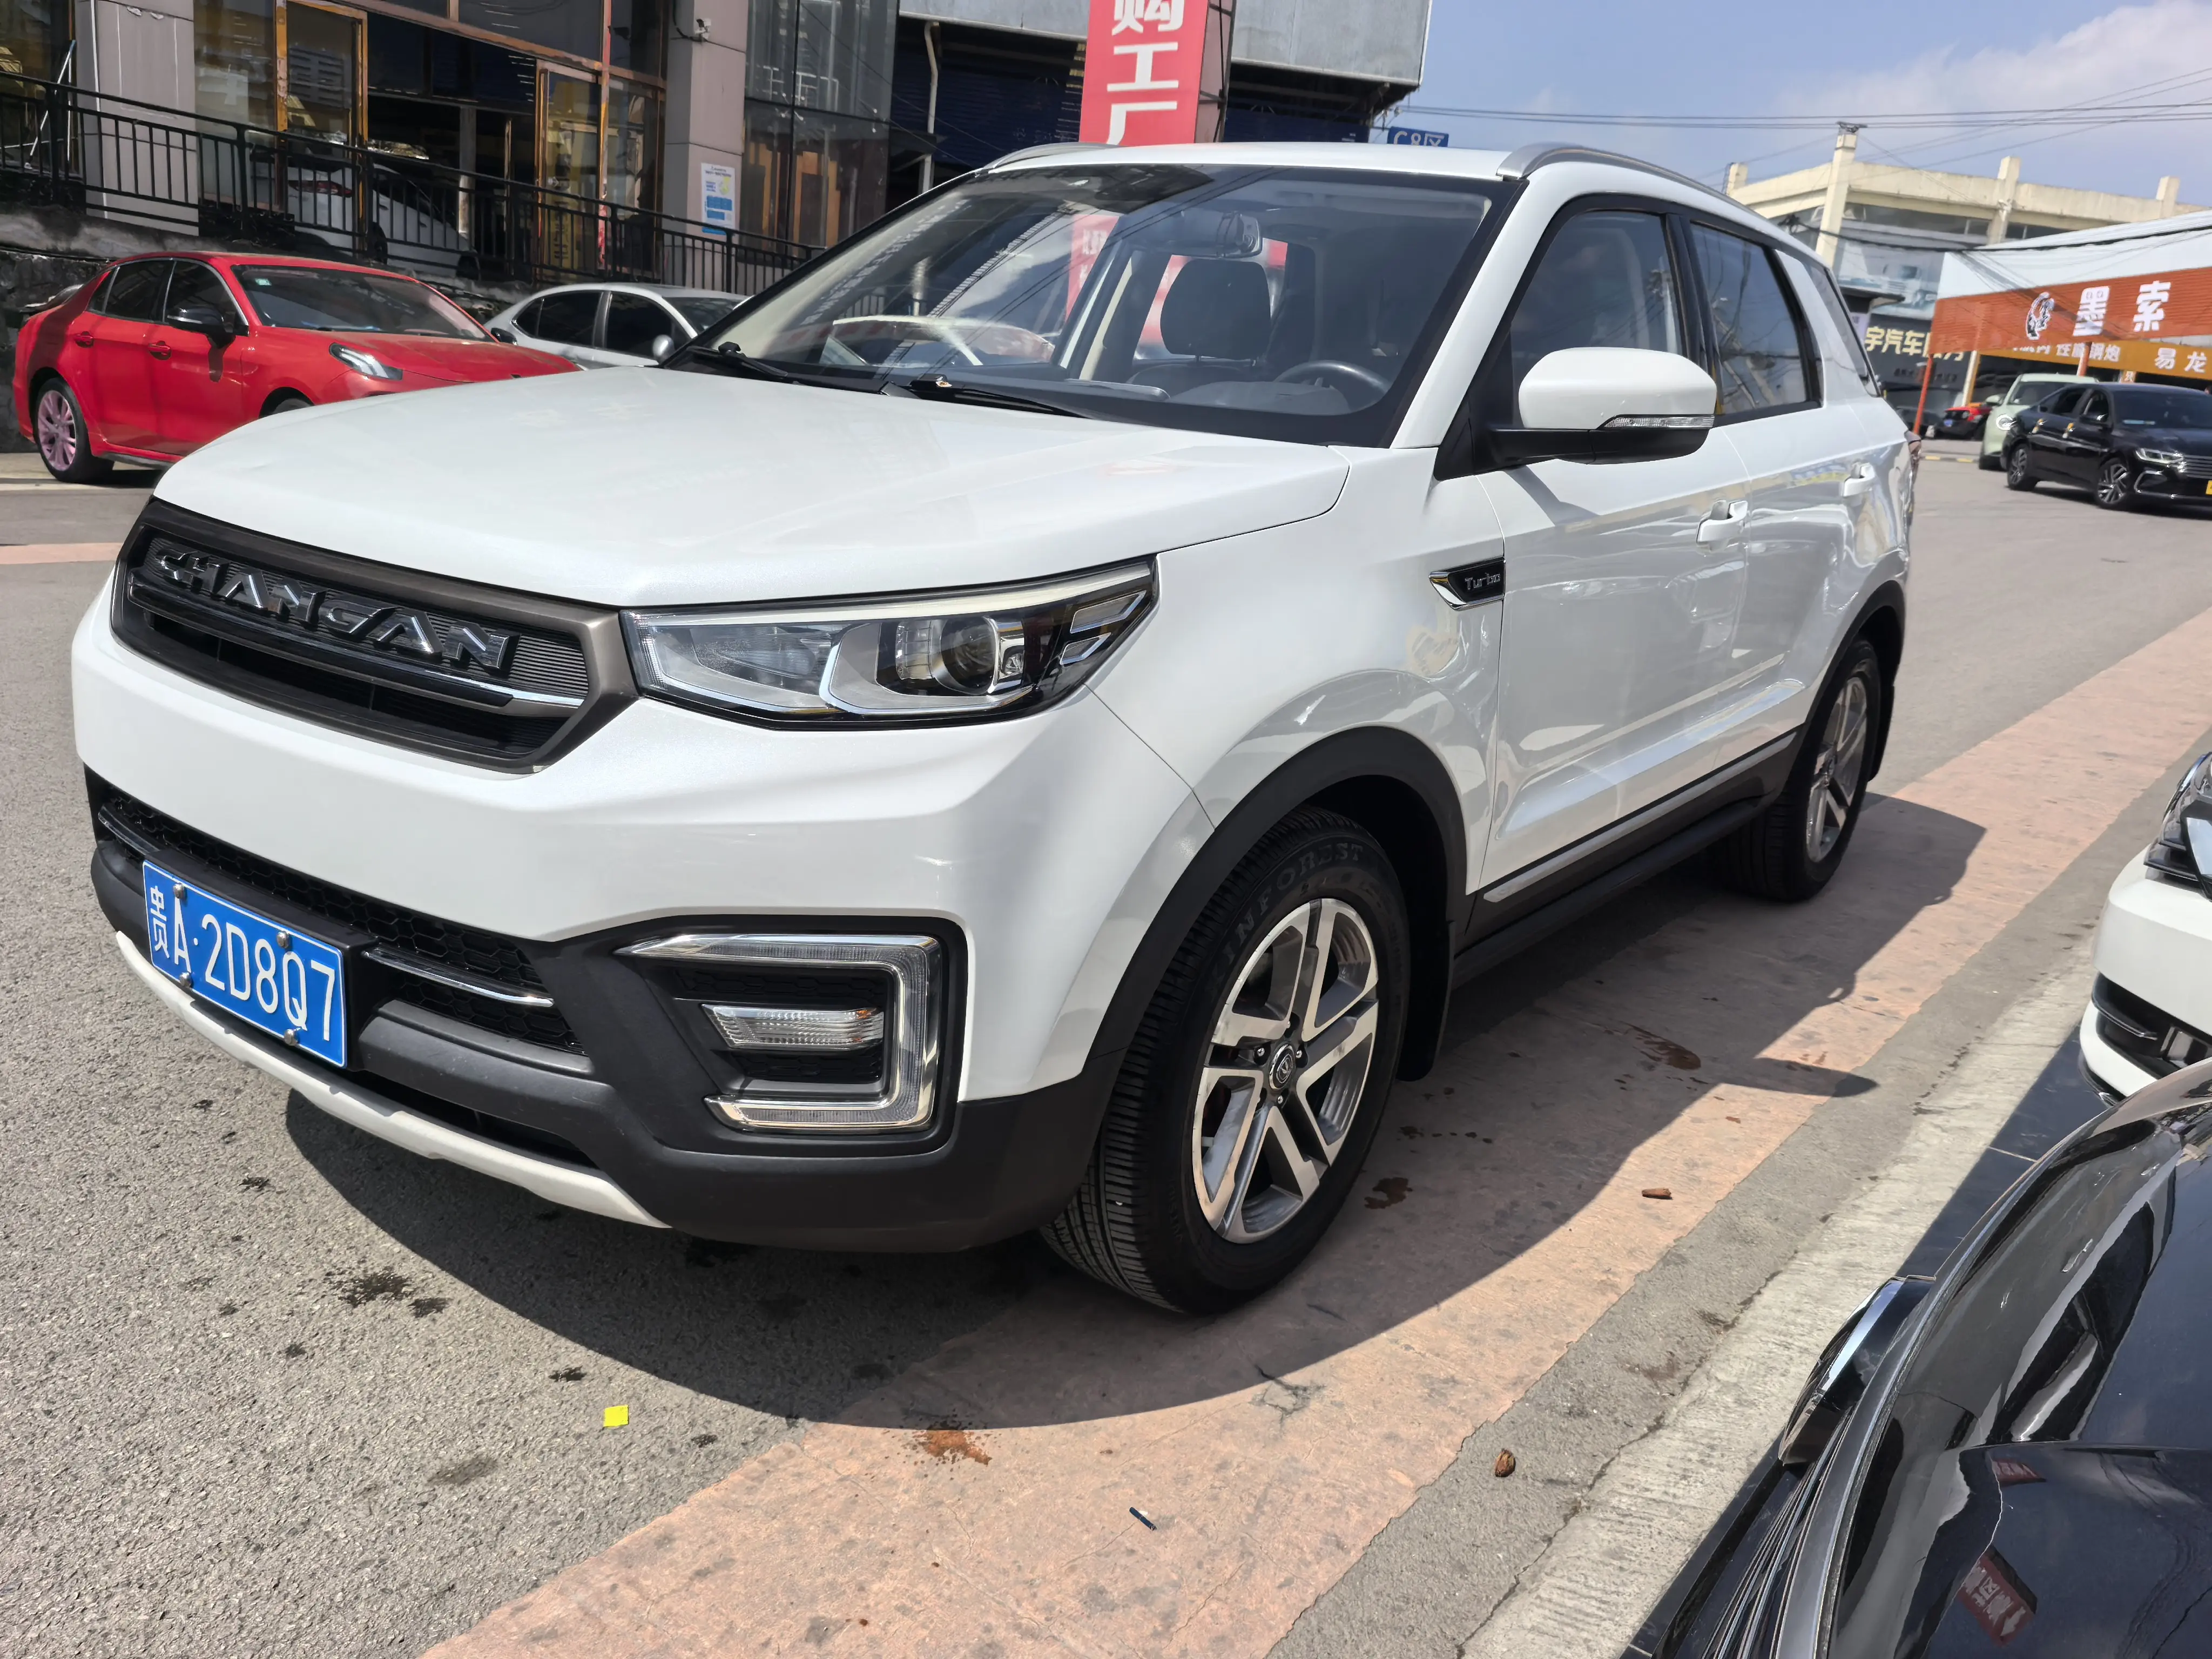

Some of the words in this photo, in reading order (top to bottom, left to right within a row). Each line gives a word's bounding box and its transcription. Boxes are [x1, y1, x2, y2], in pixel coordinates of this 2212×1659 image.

[2073, 280, 2171, 337] 墨索
[1465, 572, 1501, 590] Turbo
[155, 548, 522, 672] CHANGAN
